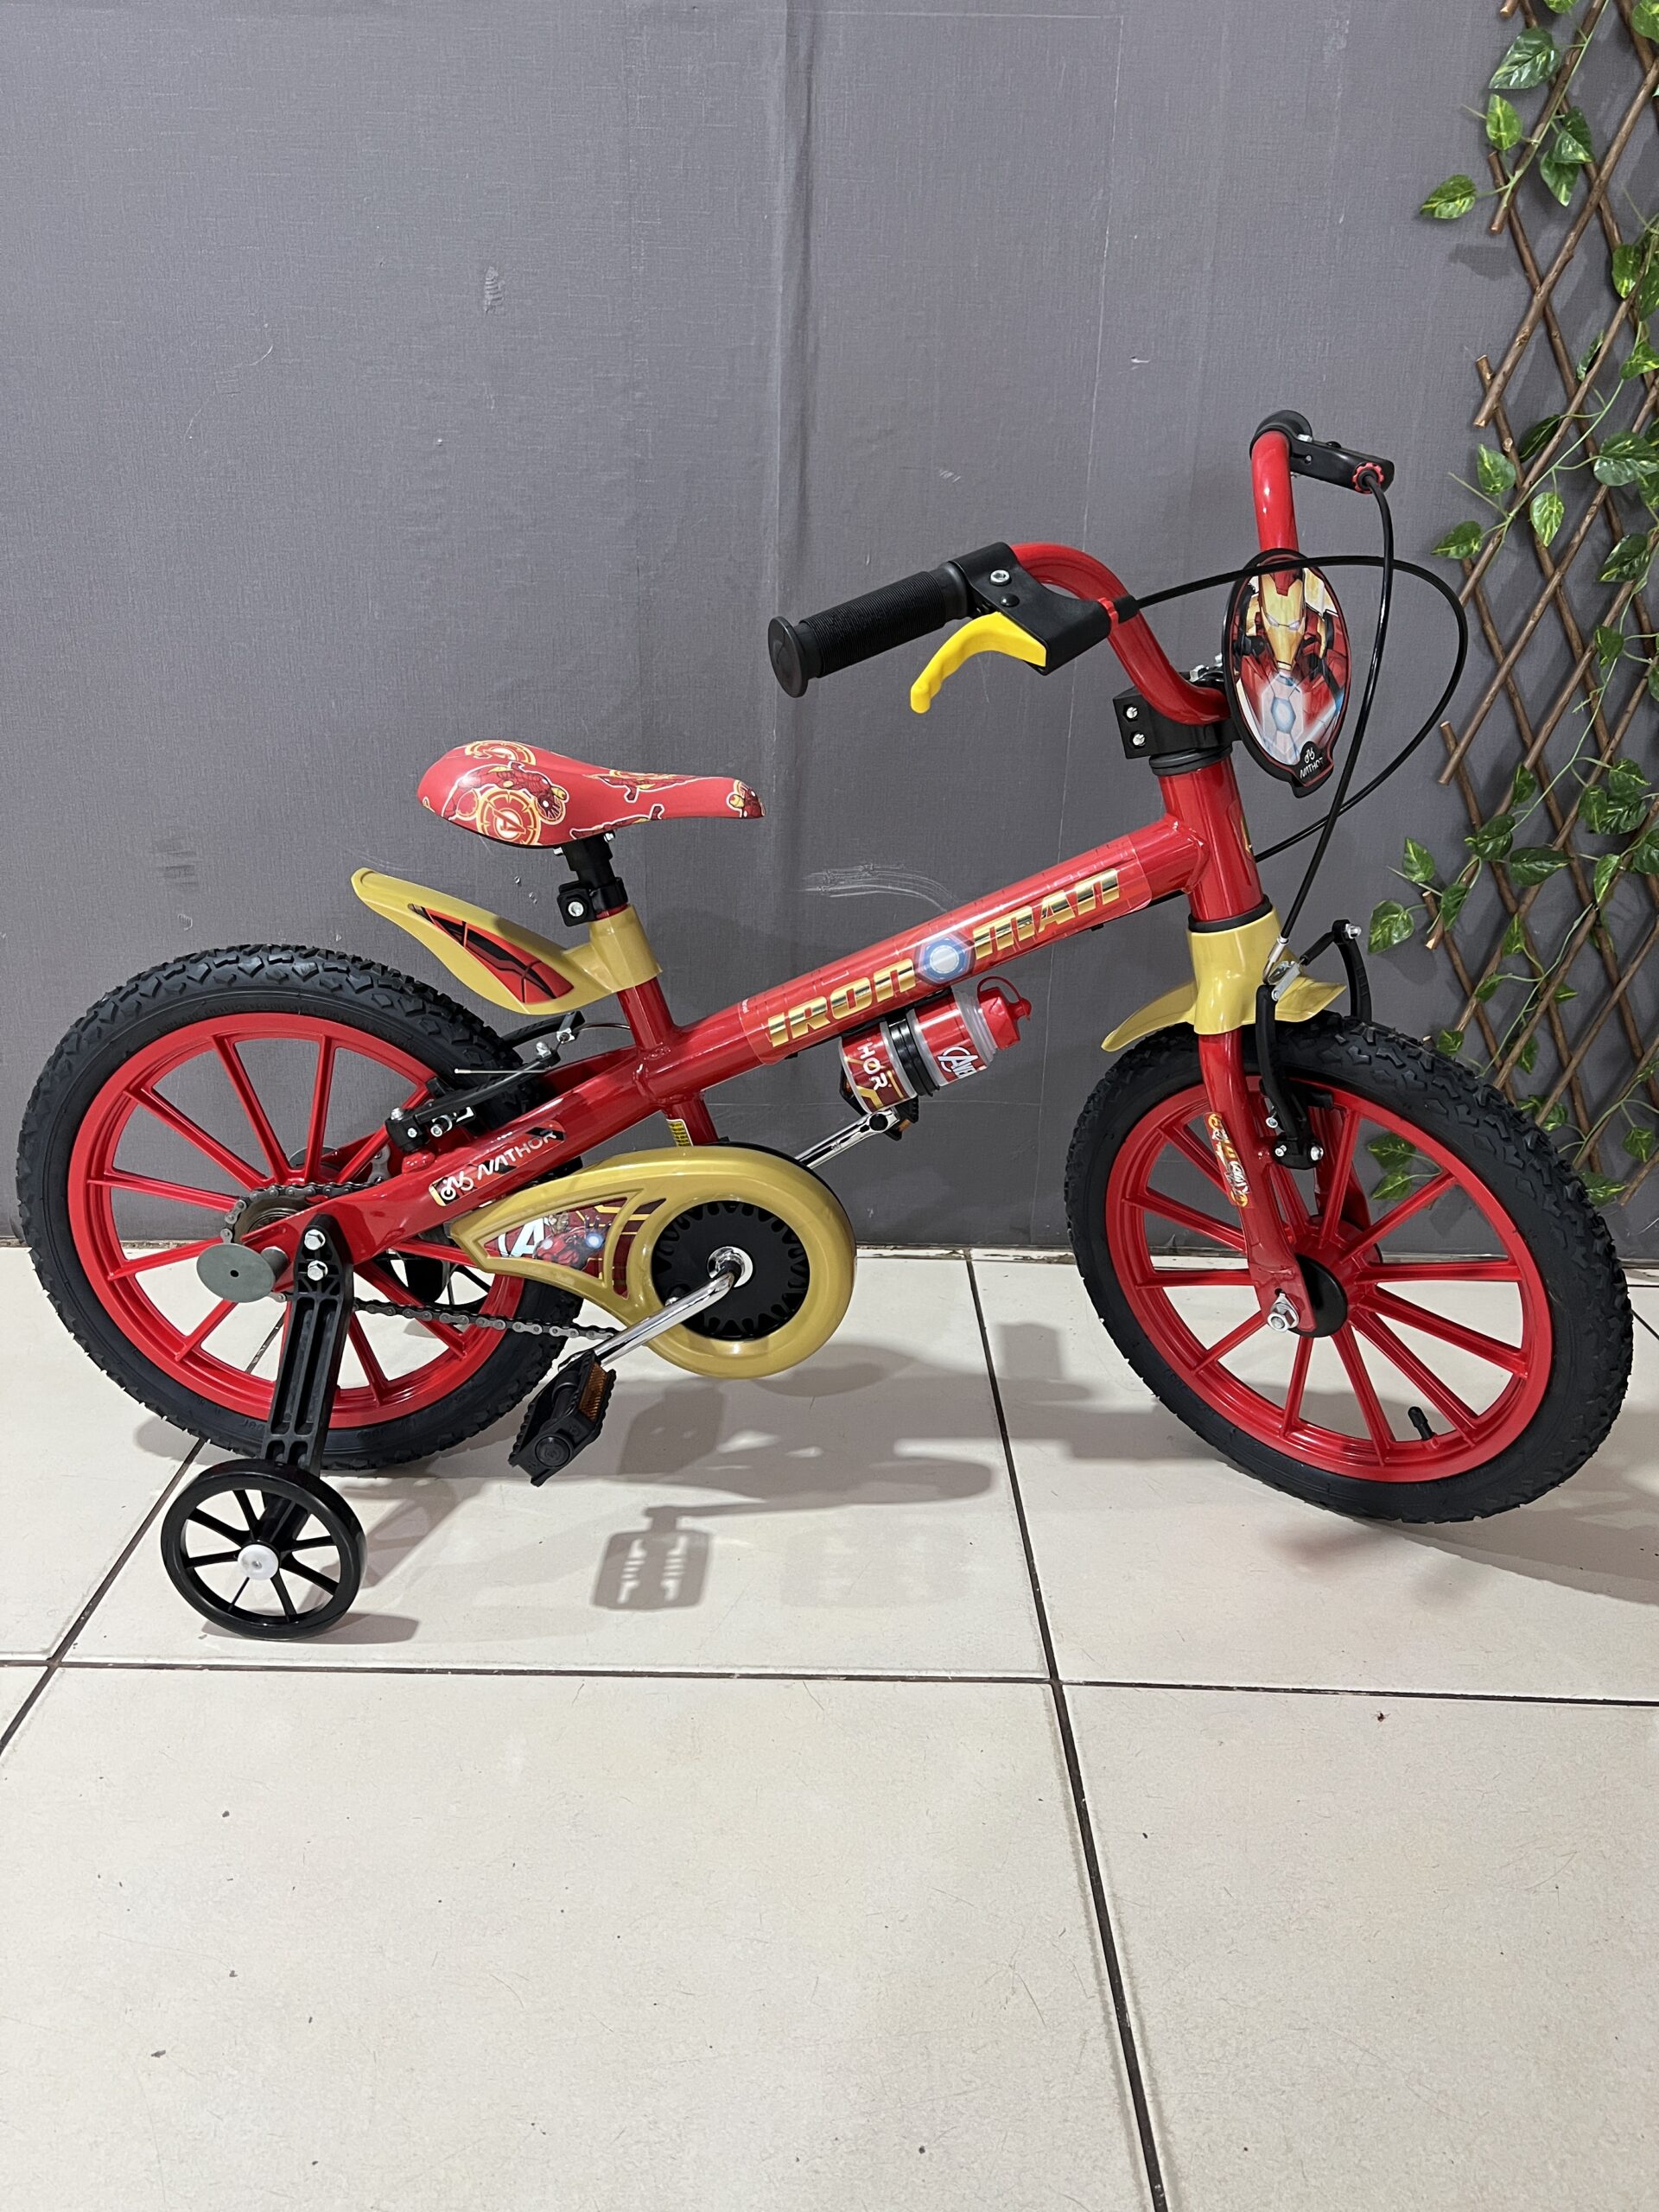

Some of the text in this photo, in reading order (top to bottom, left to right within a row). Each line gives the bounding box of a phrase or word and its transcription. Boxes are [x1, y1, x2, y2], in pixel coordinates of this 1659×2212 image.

[767, 868, 1120, 1047] IRON MAN
[857, 1039, 888, 1090] HOR
[477, 1129, 557, 1180] NATHOR
